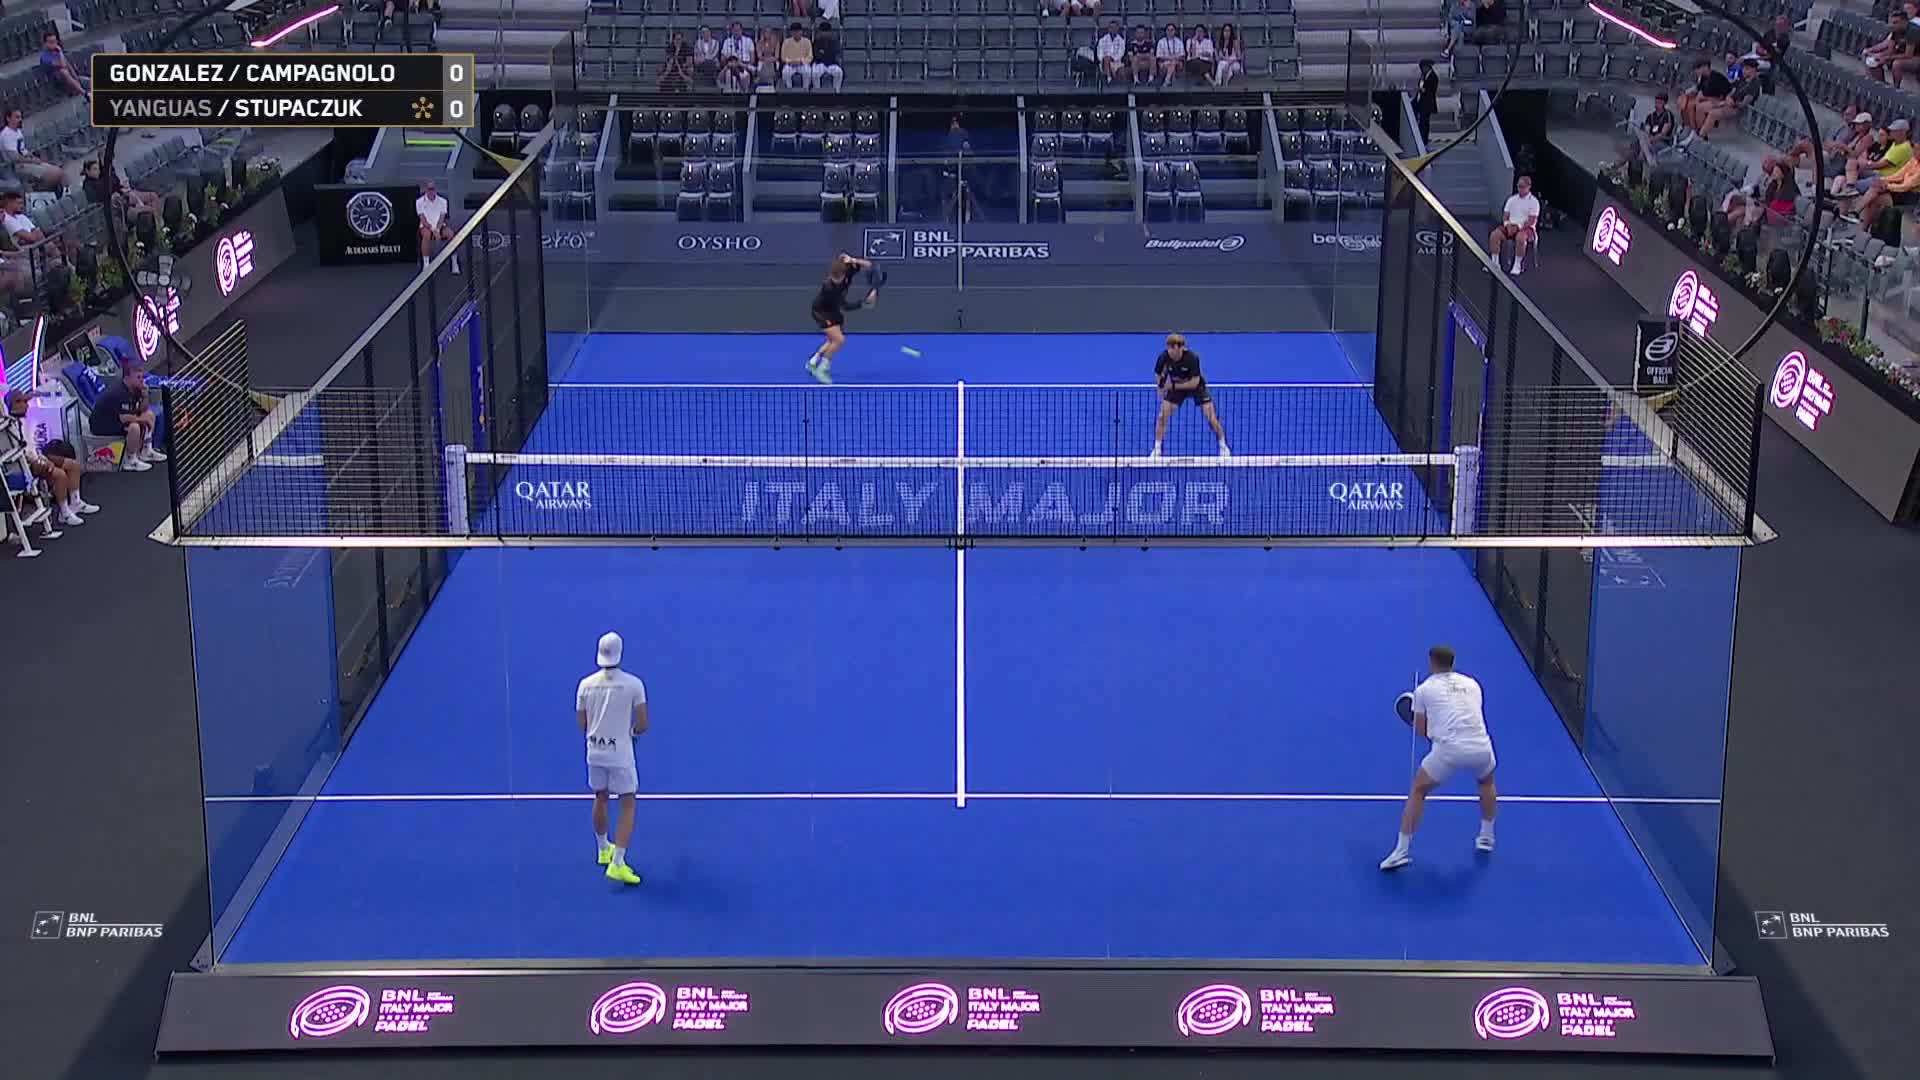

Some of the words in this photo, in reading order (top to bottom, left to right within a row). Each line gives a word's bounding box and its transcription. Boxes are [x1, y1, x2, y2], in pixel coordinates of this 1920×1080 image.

[678, 235, 762, 250] OYSHO
[913, 231, 955, 243] BNL
[1145, 239, 1221, 250] Bullpadel
[913, 246, 957, 258] BNP
[961, 246, 1049, 258] PARIBAS
[515, 481, 591, 502] QATAR
[1329, 482, 1404, 503] QATAR
[536, 499, 592, 510] AIRWAYS
[742, 481, 937, 526] ITALY
[967, 481, 1230, 526] MAJOR
[1347, 500, 1404, 511] AIRWAYS
[68, 912, 98, 923] BNL
[1789, 912, 1821, 923] BNL
[66, 927, 97, 938] BNP
[100, 927, 163, 938] PARIBAS
[1792, 927, 1824, 938] BNP
[1826, 927, 1890, 938] PARIBAS
[381, 989, 425, 1002] BNL
[676, 987, 719, 1000] BNL
[968, 987, 1011, 1000] BNL
[1260, 989, 1303, 1002] BNL
[1556, 993, 1602, 1006] BNL
[379, 1003, 412, 1014] ITALY
[413, 1003, 454, 1013] MAJOR
[675, 1000, 708, 1011] ITALY
[708, 1000, 748, 1011] MAJOR
[968, 1001, 1000, 1012] ITALY
[1000, 1001, 1041, 1012] MAJOR
[1261, 1003, 1293, 1014] ITALY
[1294, 1003, 1334, 1014] MAJOR
[1559, 1007, 1592, 1018] ITALY
[1593, 1007, 1635, 1019] MAJOR
[374, 1021, 428, 1032] PADEL
[672, 1018, 725, 1030] PADEL
[966, 1019, 1019, 1030] PADEL
[1261, 1021, 1314, 1032] PADEL
[1561, 1024, 1616, 1036] PADEL
